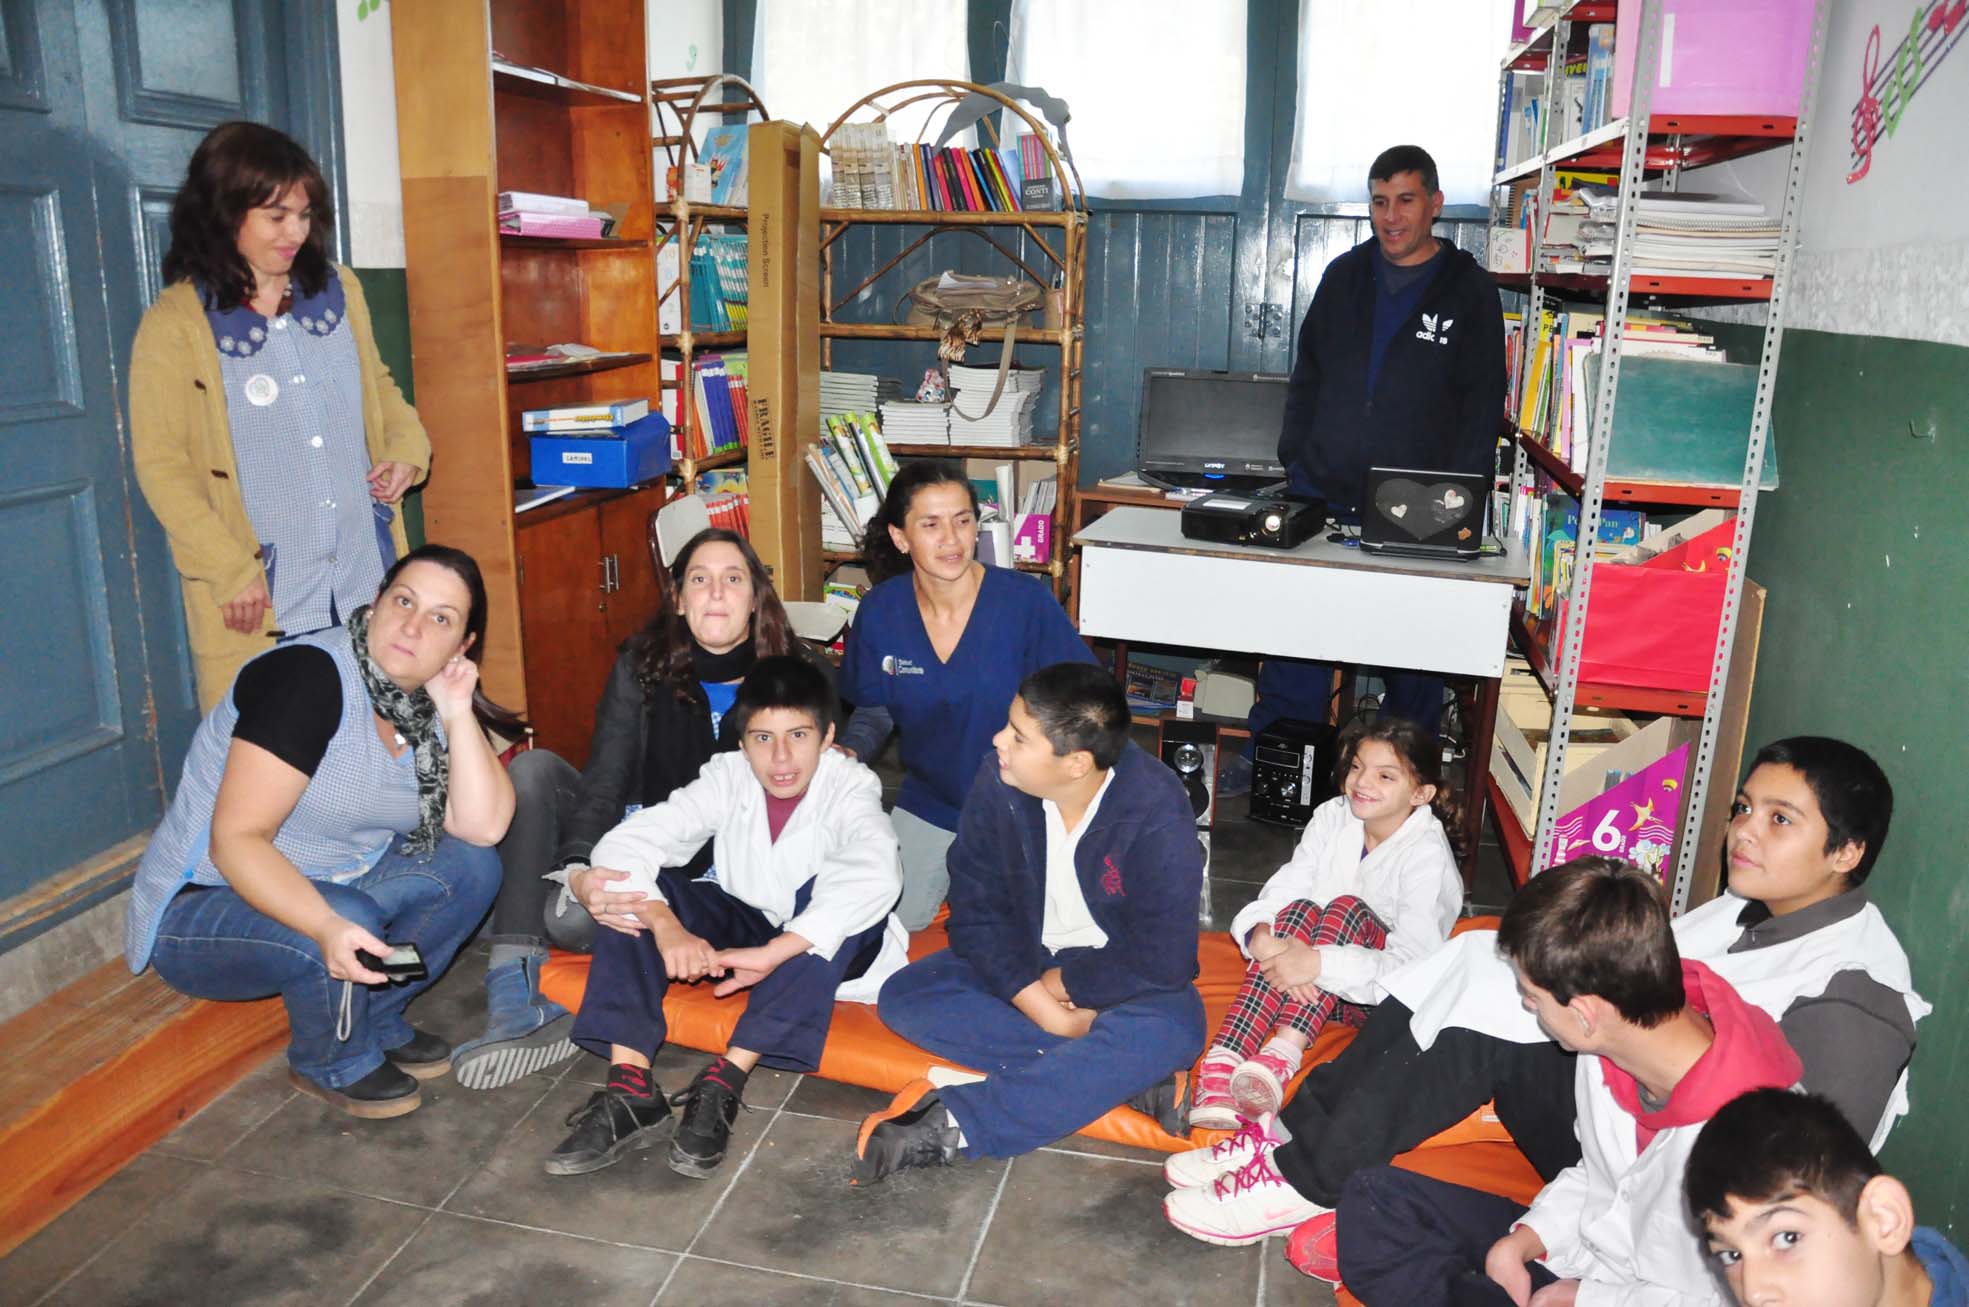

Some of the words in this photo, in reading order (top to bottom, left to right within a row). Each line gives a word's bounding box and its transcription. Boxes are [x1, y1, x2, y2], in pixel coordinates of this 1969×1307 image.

[1025, 187, 1049, 195] CONTI
[760, 213, 769, 256] Projection
[762, 258, 770, 287] Screen
[758, 398, 774, 459] FRAGILE
[1037, 519, 1045, 544] GRADO
[1592, 809, 1621, 852] 6
